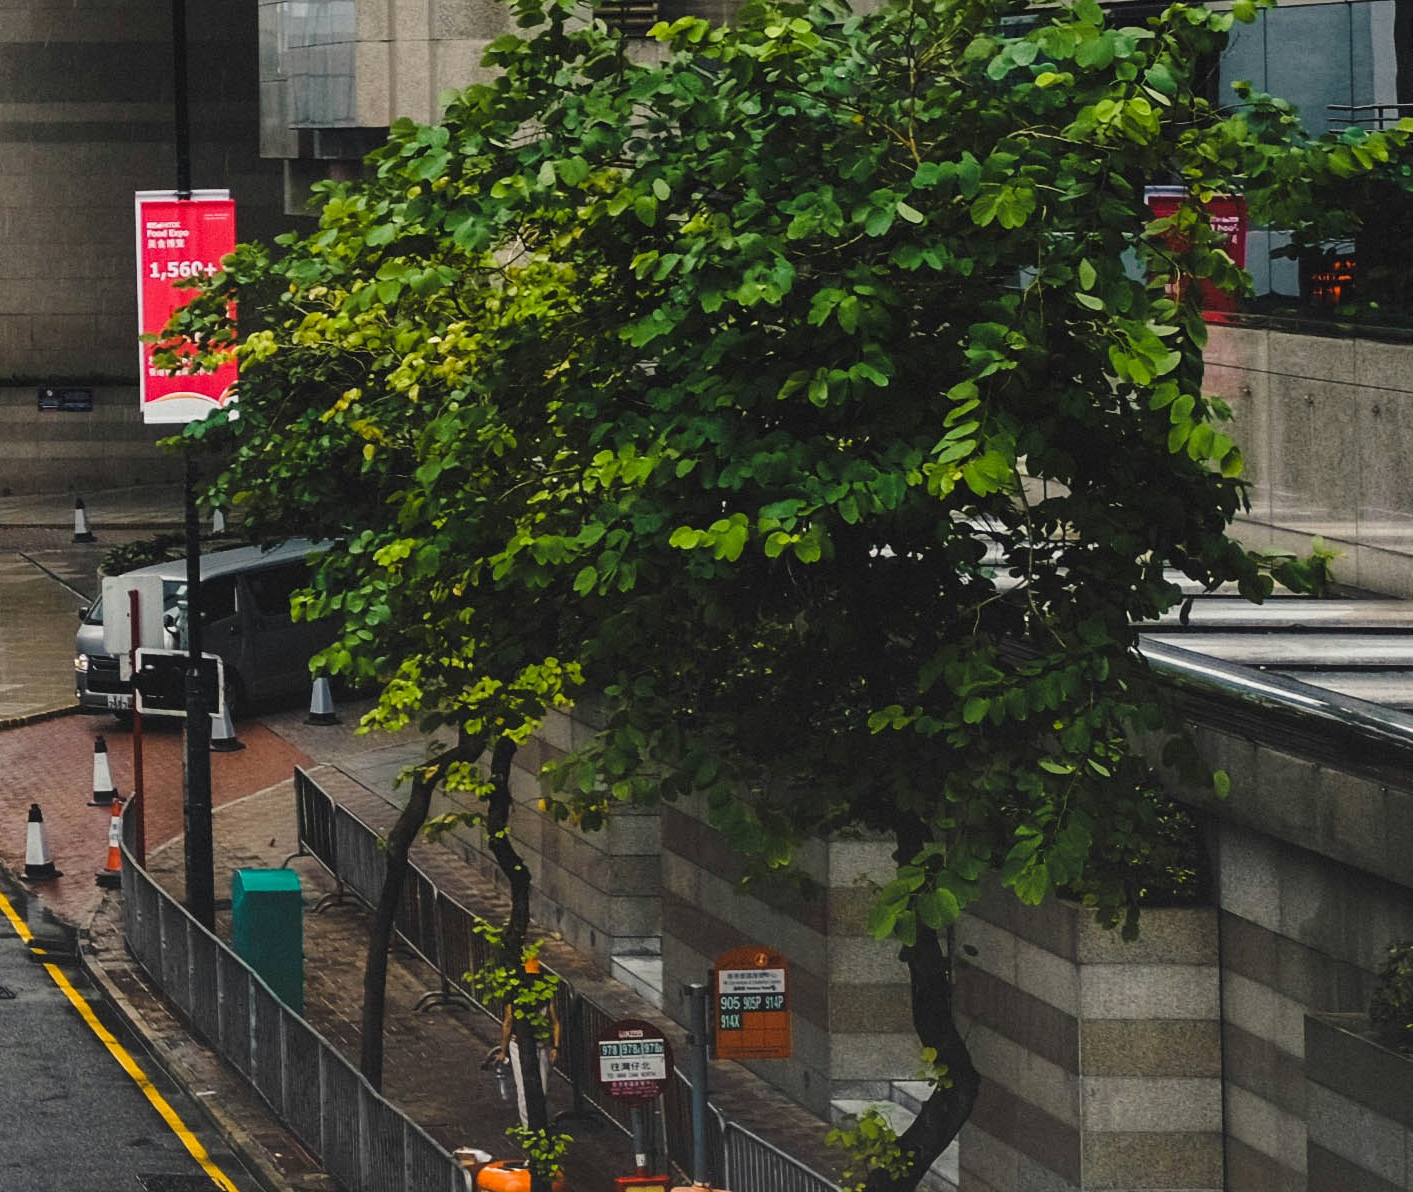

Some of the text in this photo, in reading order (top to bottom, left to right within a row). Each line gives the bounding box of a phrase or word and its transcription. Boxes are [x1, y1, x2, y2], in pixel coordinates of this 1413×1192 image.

[147, 229, 190, 238] Food Expo
[149, 260, 218, 281] 1,560+
[720, 995, 784, 1010] 905 905P 914P
[720, 1014, 740, 1029] 914X
[601, 1045, 618, 1056] 978
